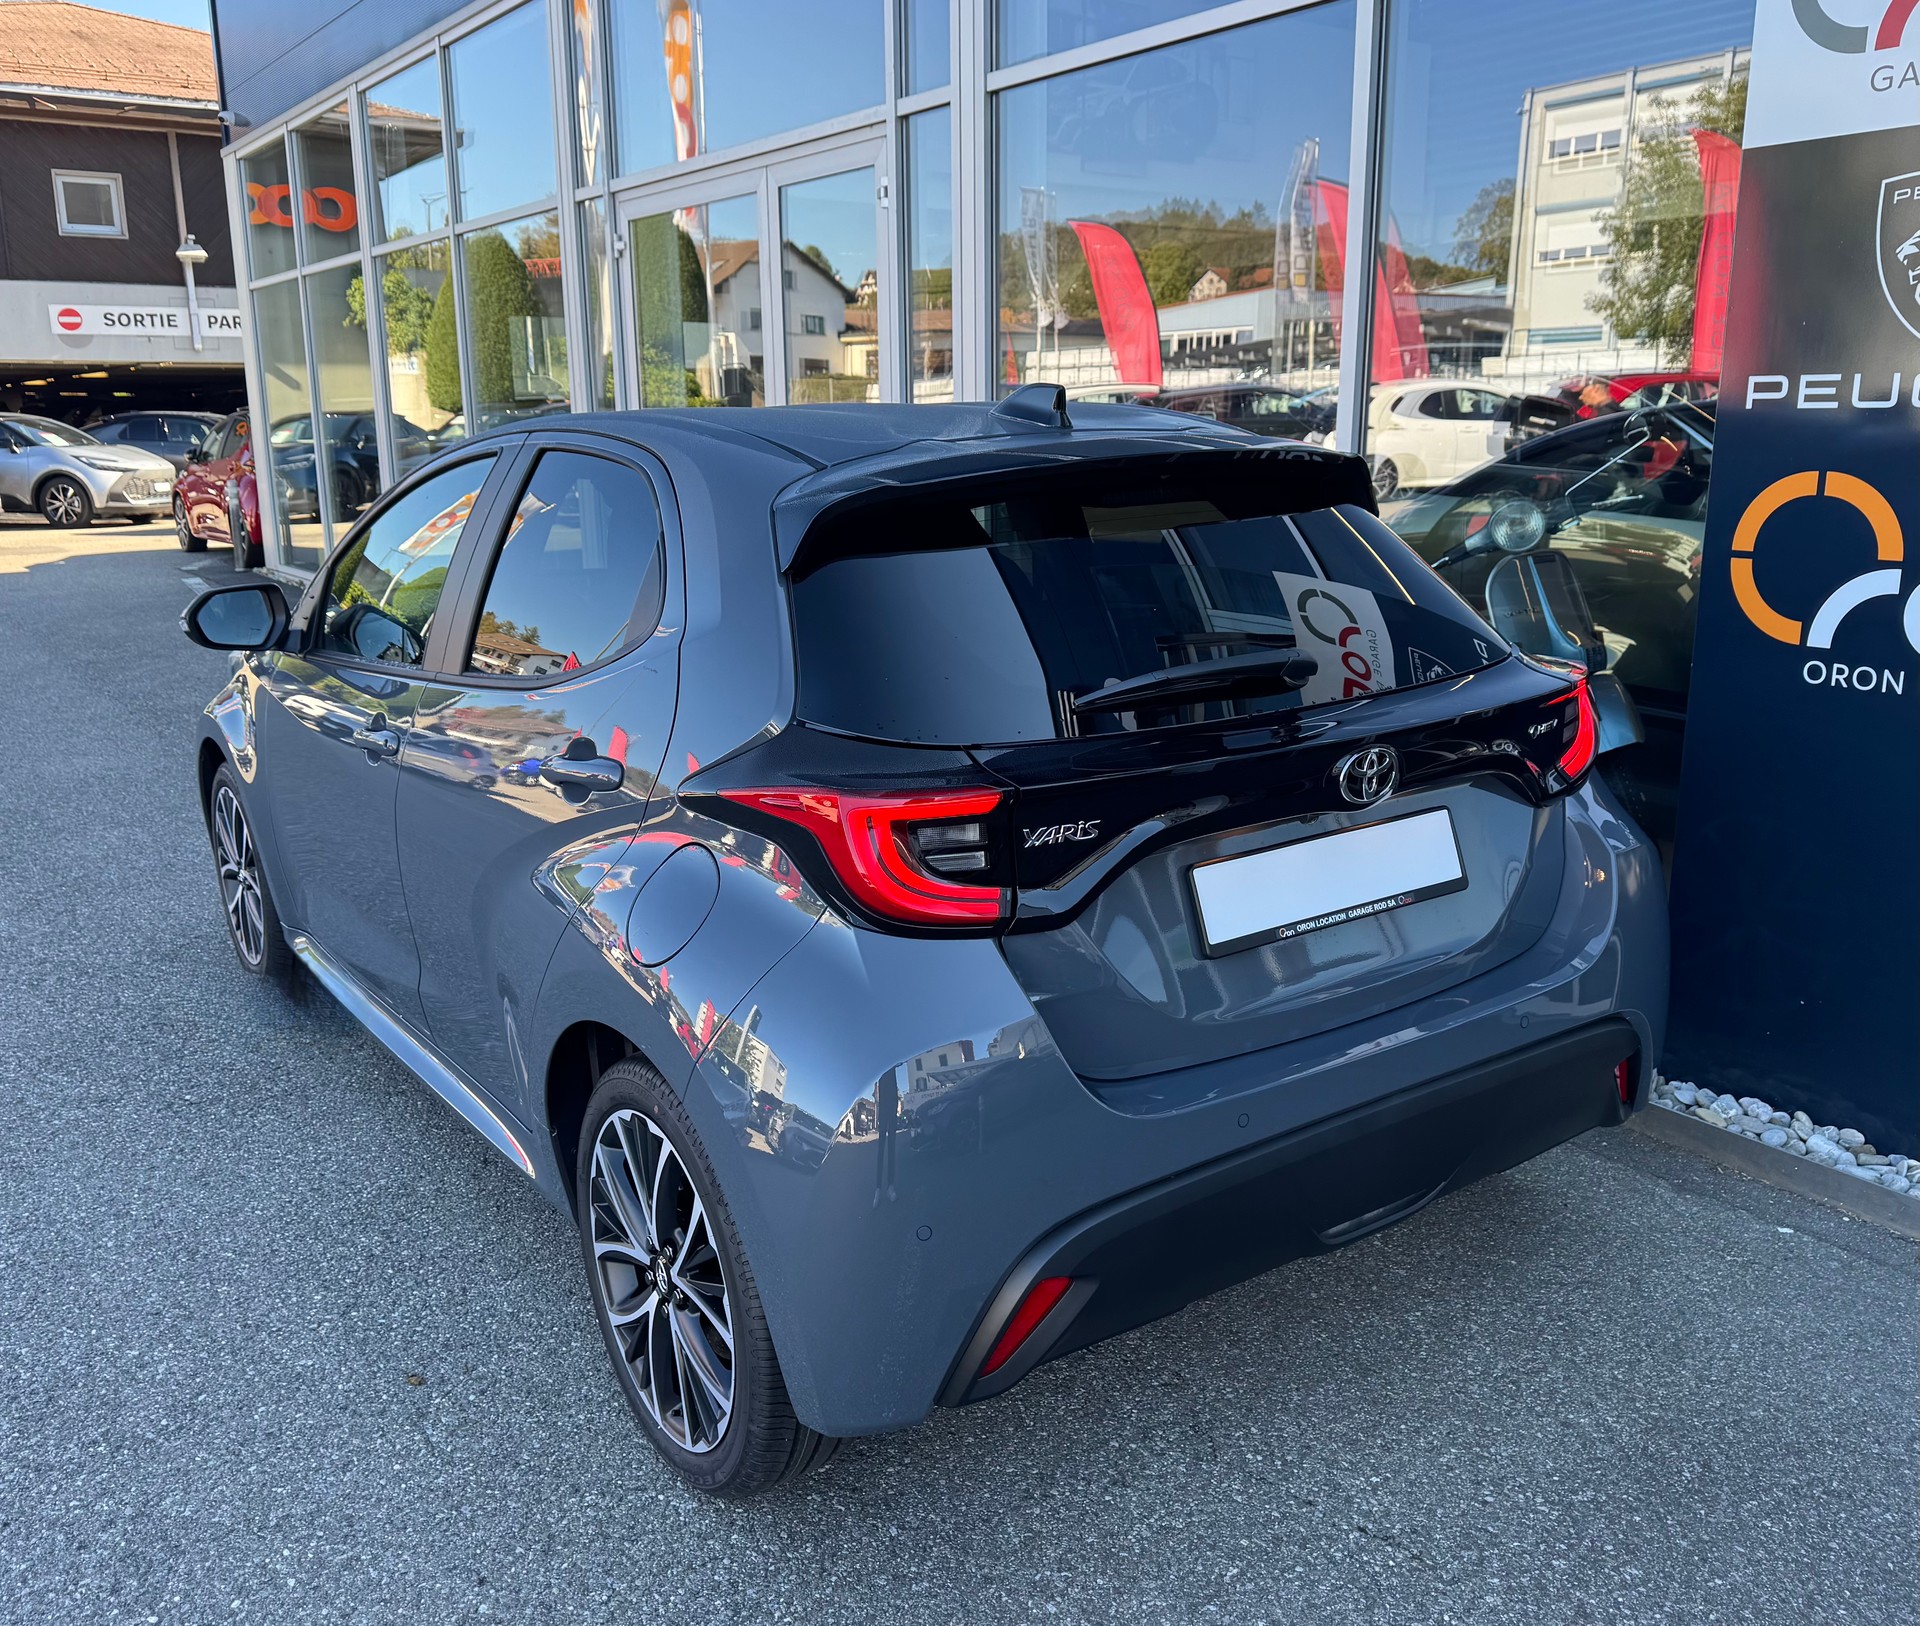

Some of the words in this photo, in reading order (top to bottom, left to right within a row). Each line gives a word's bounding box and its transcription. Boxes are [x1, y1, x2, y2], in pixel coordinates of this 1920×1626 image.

[1870, 61, 1920, 92] GA
[103, 312, 178, 328] SORTIE
[207, 315, 241, 329] PAR
[1745, 372, 1920, 410] PEU
[1803, 660, 1905, 695] ORON
[1296, 921, 1316, 932] ORON
[1315, 912, 1347, 927] LOCATION
[1348, 904, 1374, 918] GARAGE
[1374, 901, 1387, 911] ROD
[1387, 899, 1397, 907] SA
